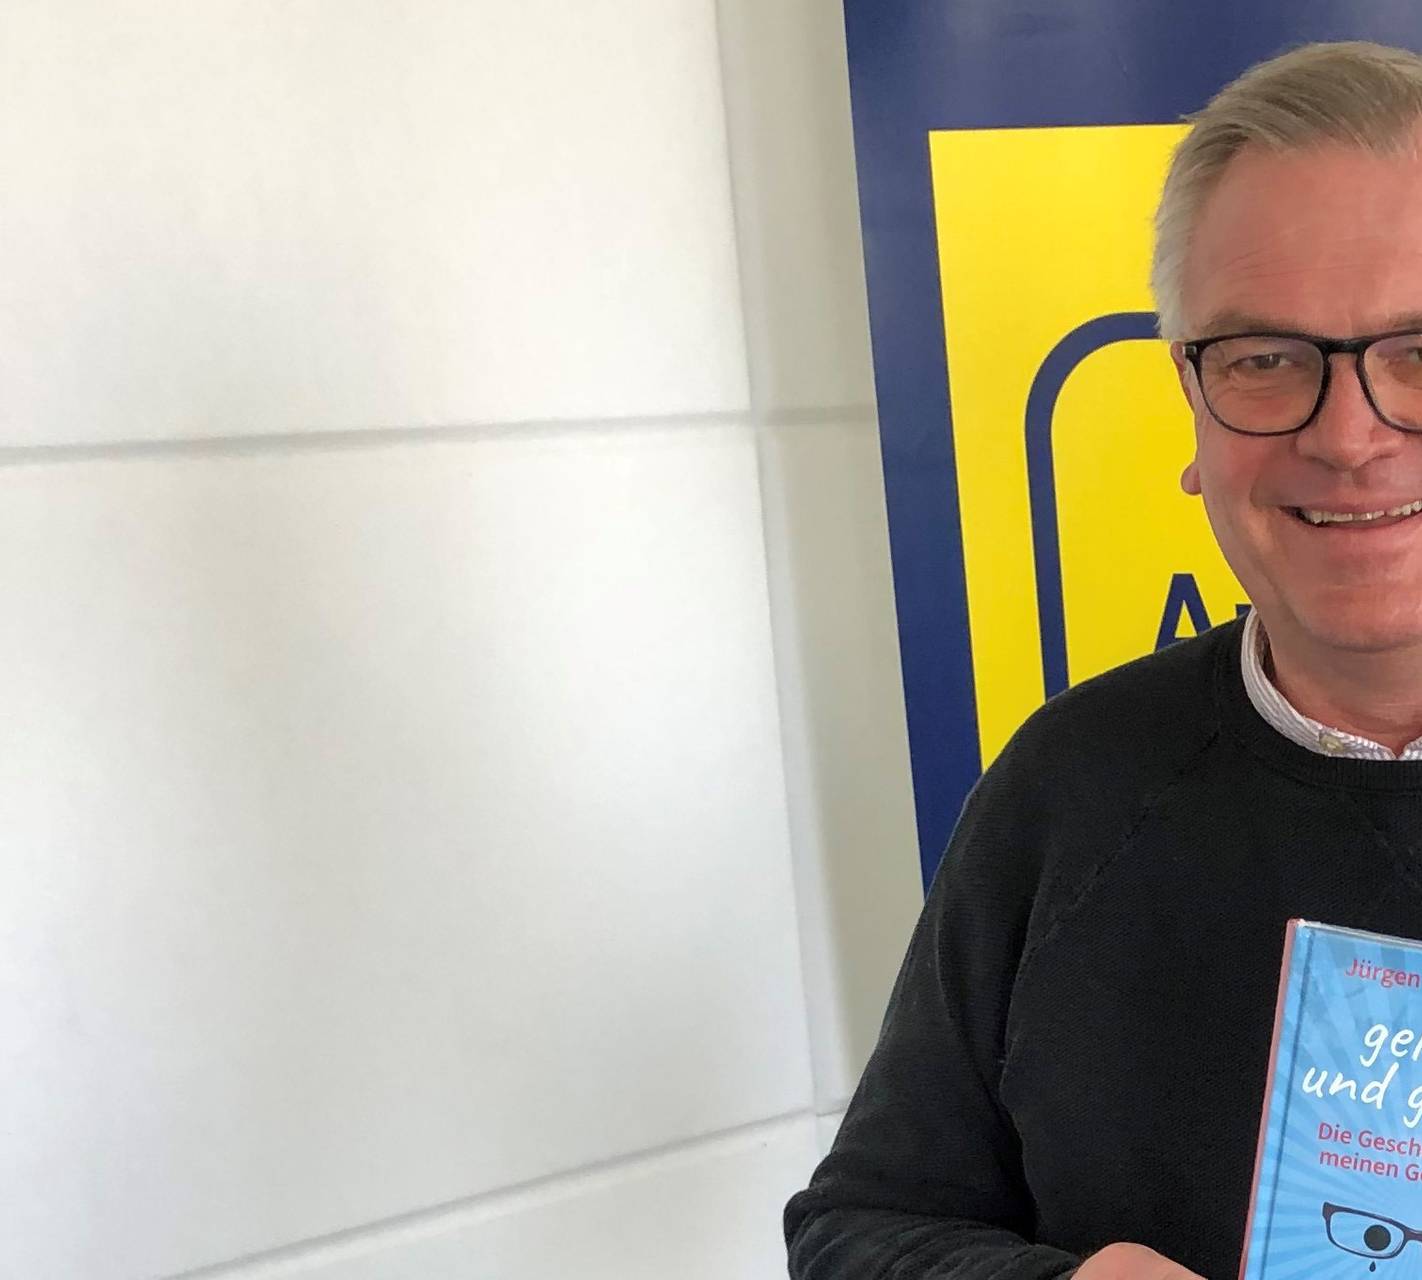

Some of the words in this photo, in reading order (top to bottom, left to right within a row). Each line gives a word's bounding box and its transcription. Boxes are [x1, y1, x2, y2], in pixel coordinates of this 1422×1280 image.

[1345, 958, 1420, 988] Jürgen
[1302, 1062, 1400, 1109] und
[1318, 1122, 1353, 1145] Die
[1319, 1150, 1399, 1178] meinen
